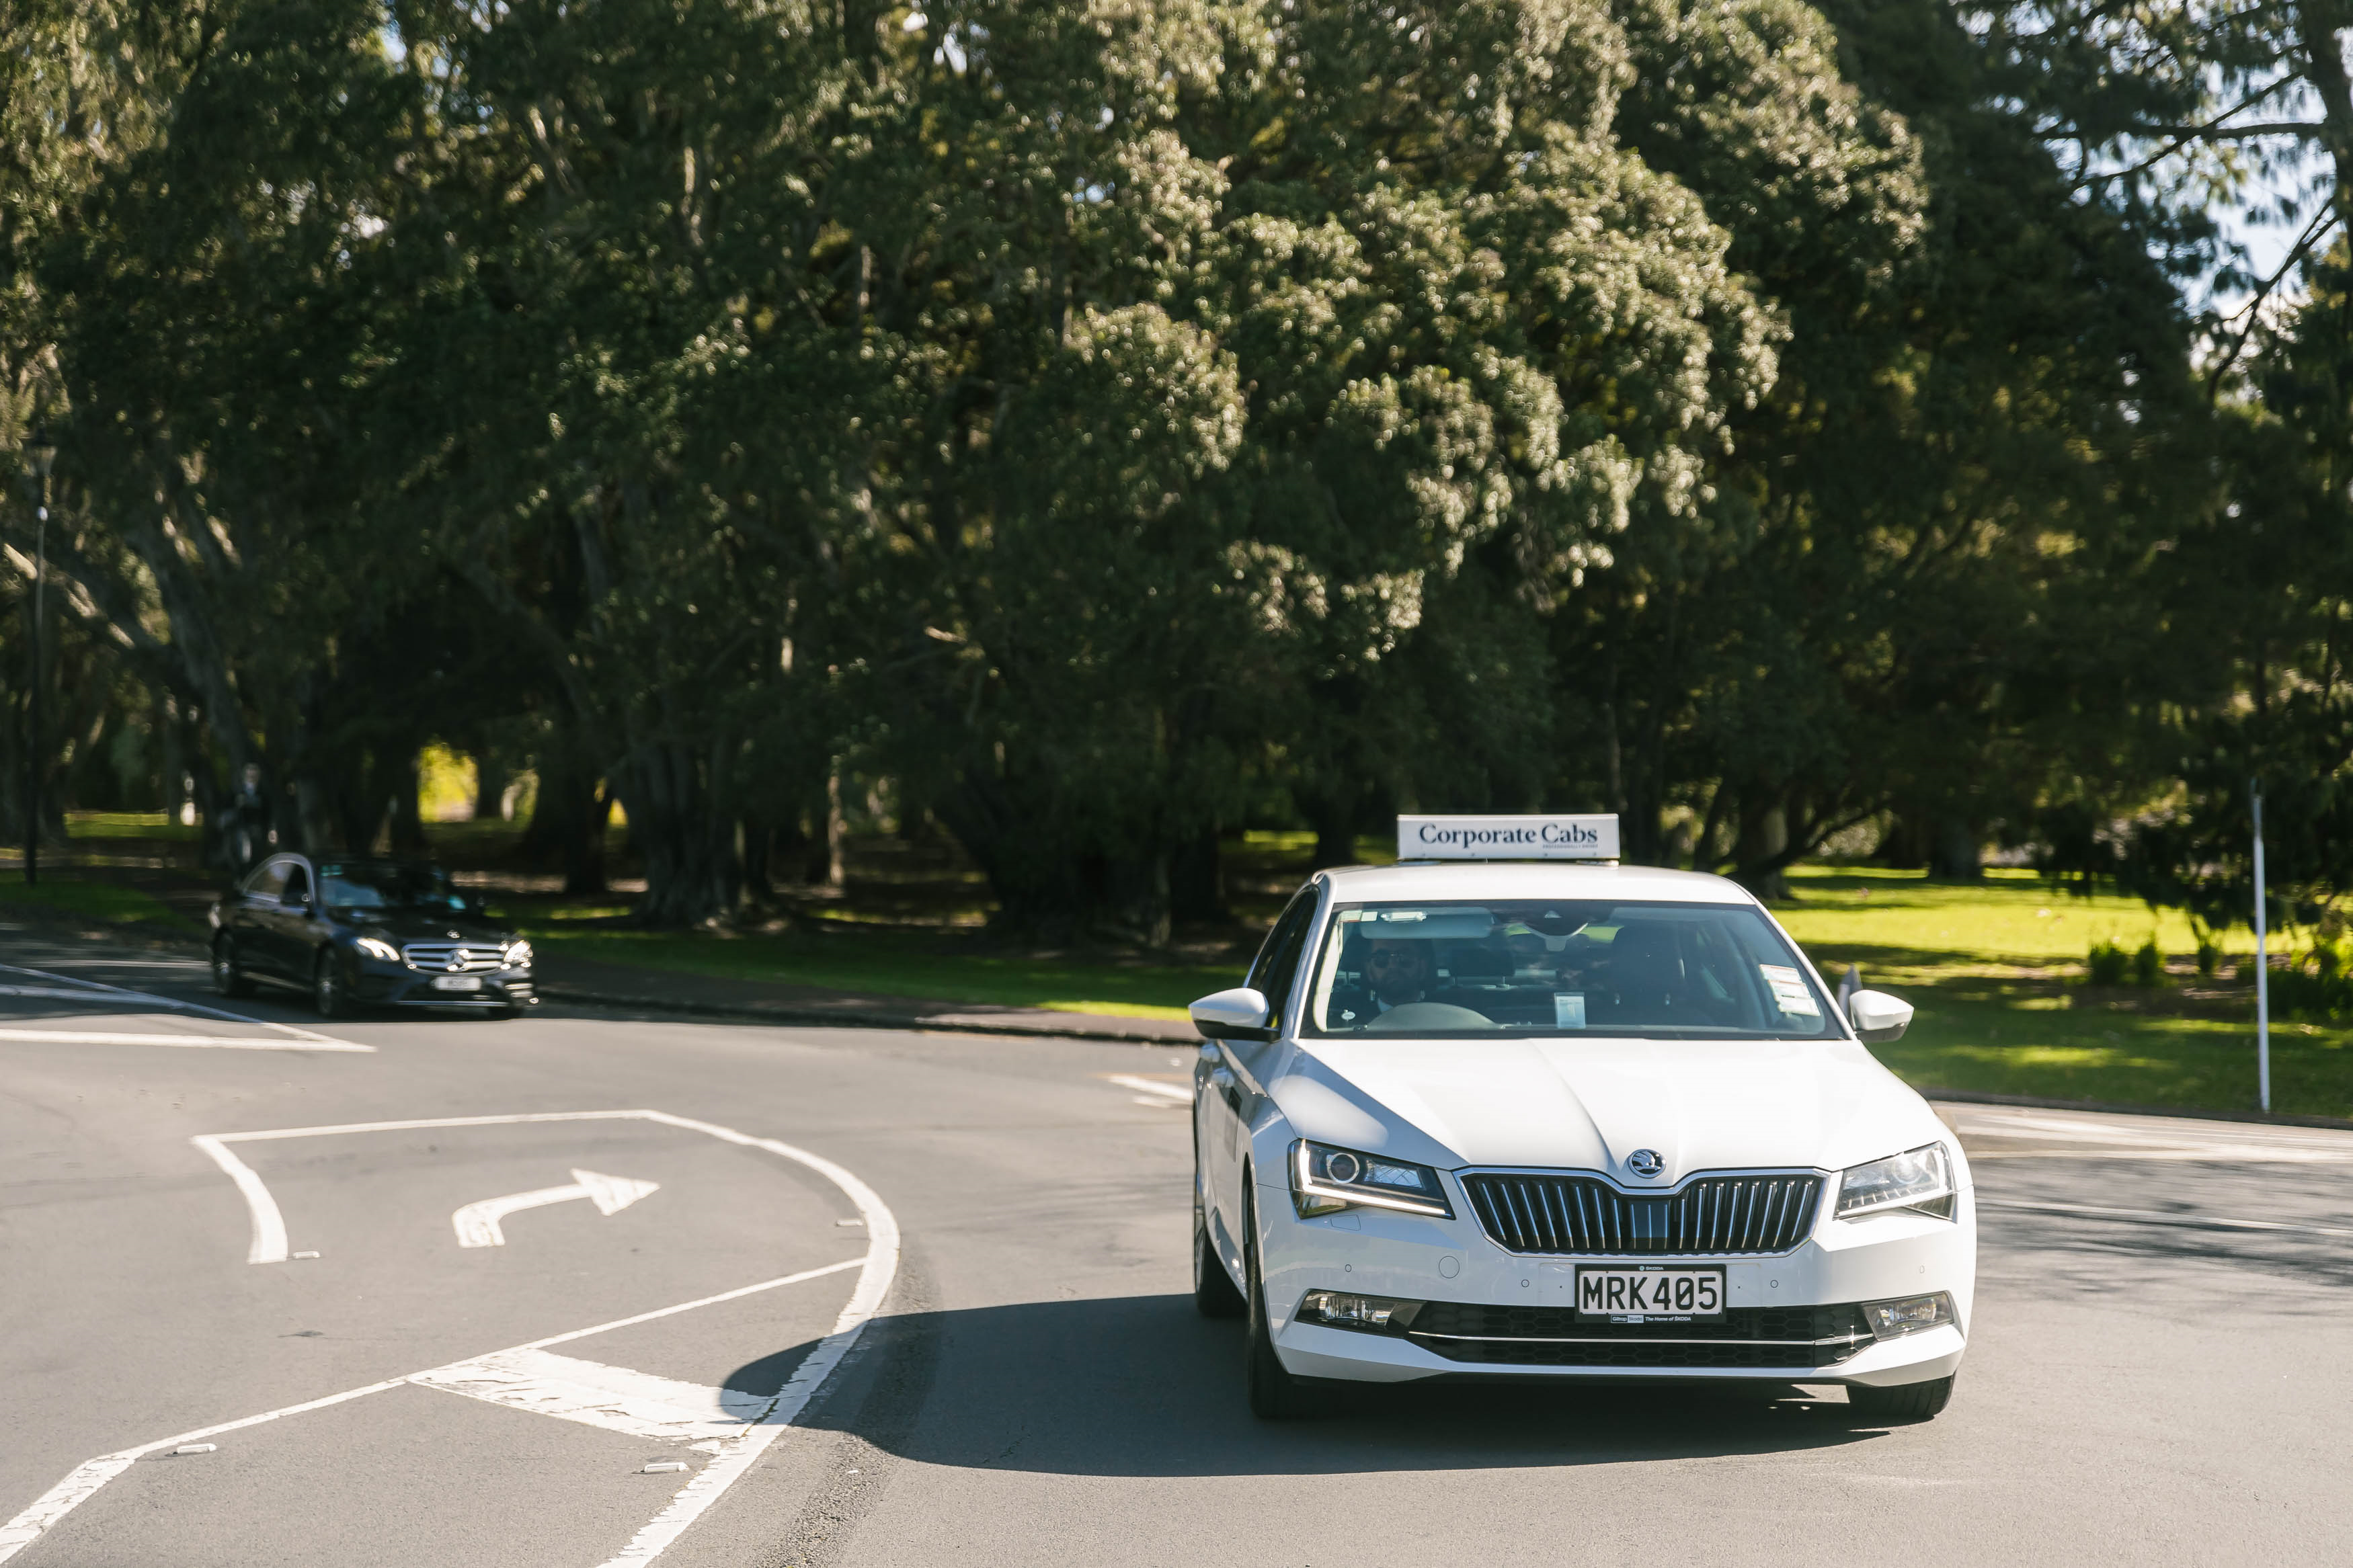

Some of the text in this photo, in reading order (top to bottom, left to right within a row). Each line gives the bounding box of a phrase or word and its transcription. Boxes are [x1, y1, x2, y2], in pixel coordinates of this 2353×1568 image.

[1419, 823, 1598, 848] Corporate Cabs
[1583, 1276, 1717, 1311] MRK405
